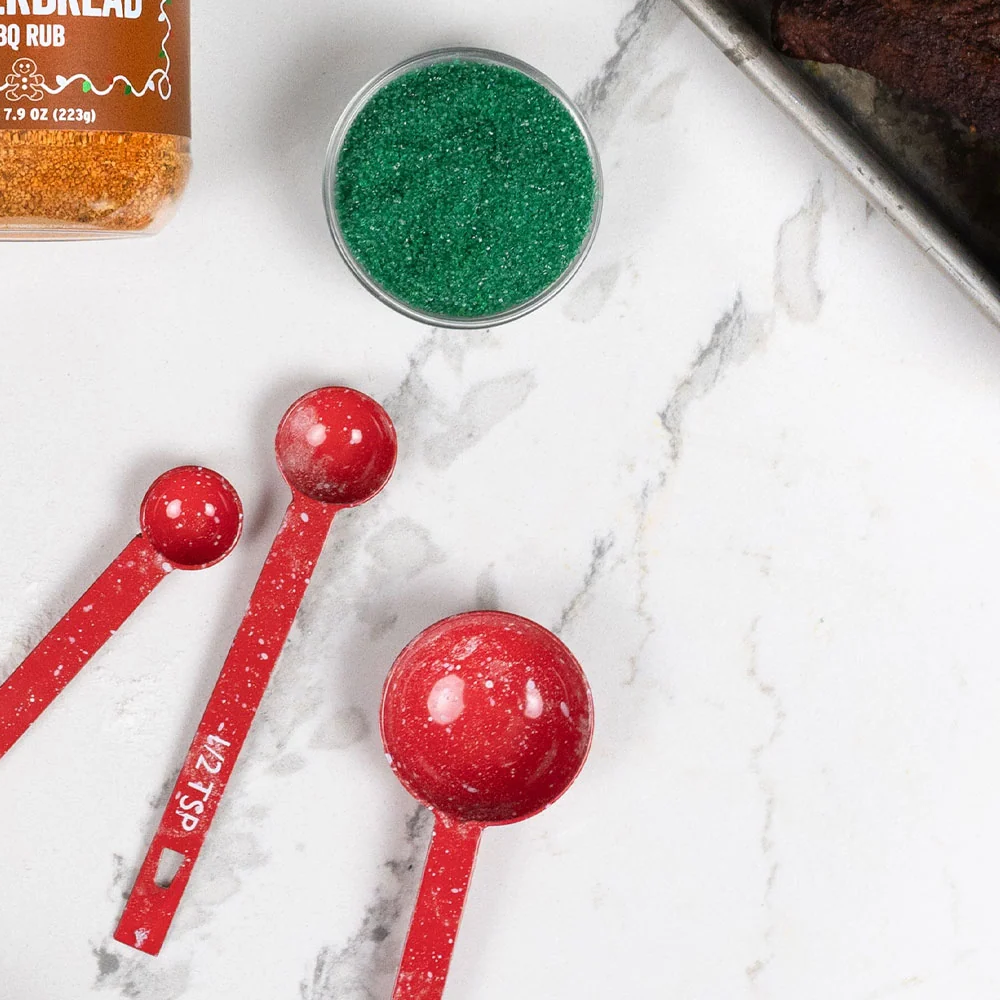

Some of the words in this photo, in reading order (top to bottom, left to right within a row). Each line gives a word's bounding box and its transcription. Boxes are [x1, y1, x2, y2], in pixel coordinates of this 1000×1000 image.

[26, 23, 66, 48] RUB
[3, 107, 26, 121] 7.9
[30, 107, 48, 122] OZ
[52, 108, 96, 124] (223g)
[195, 735, 231, 775] 1/2
[176, 781, 214, 832] TSP
